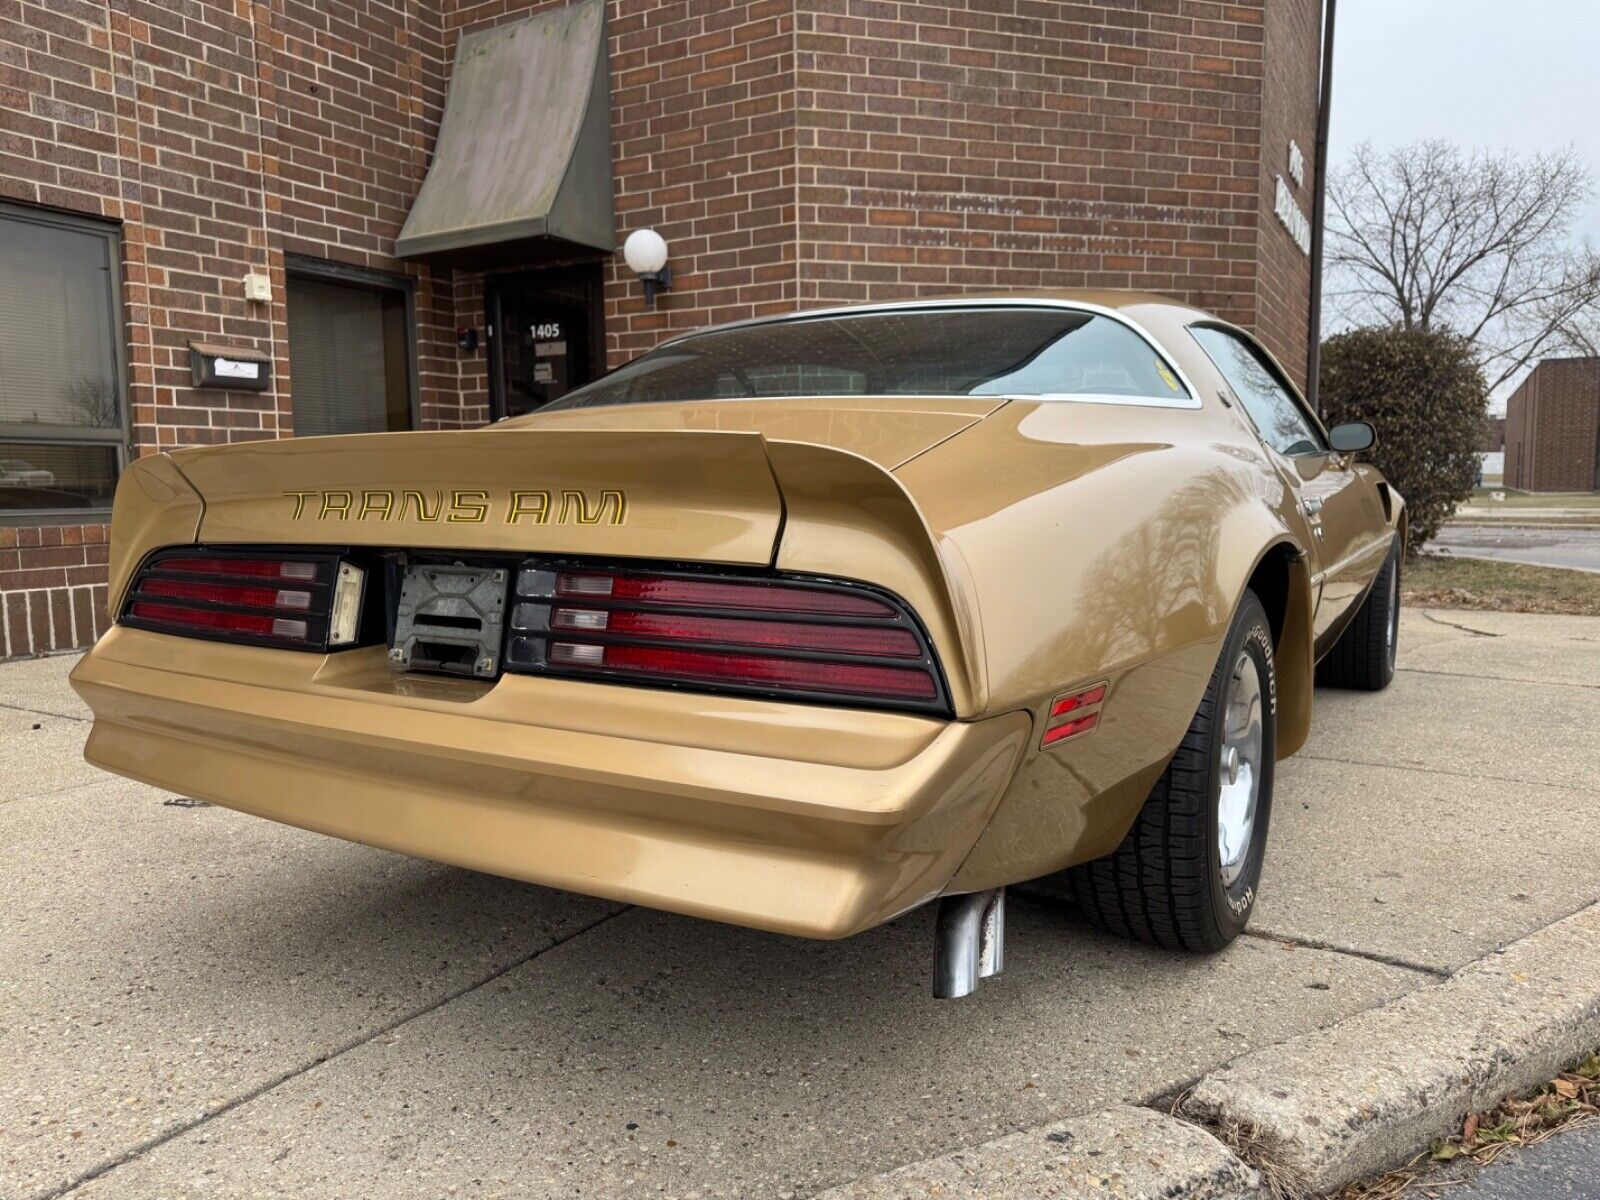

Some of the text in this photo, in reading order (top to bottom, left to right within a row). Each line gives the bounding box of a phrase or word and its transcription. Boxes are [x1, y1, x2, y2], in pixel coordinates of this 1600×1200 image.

[530, 323, 560, 339] 1405
[281, 488, 629, 526] TRANS AM
